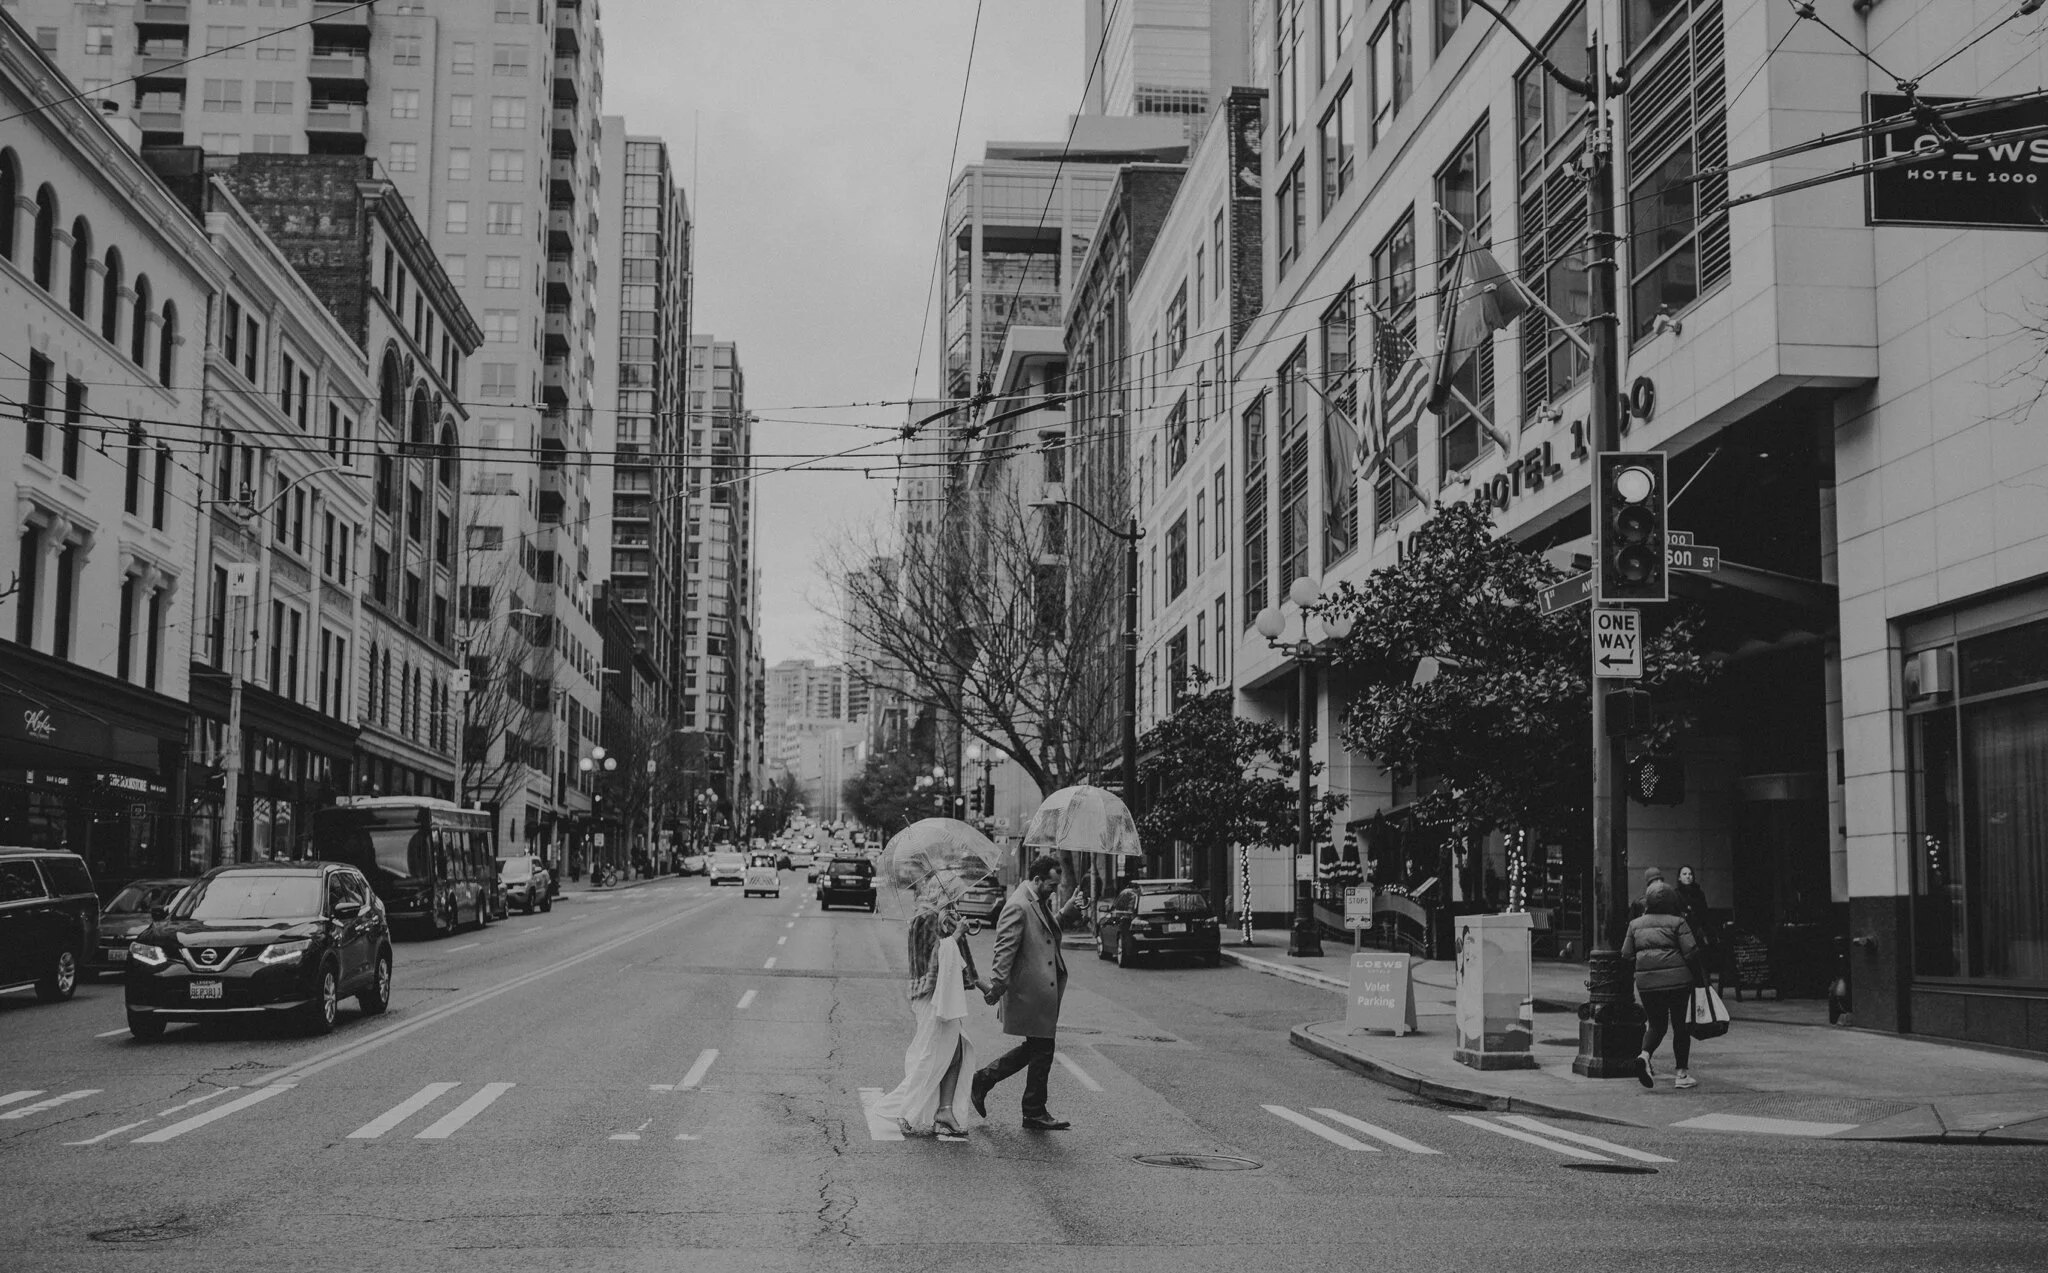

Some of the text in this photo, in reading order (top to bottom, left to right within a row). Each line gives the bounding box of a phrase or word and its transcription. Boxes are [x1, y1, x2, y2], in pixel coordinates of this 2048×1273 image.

[1885, 133, 2048, 163] LOWS
[1907, 169, 2038, 184] HOTEL 1000
[1702, 556, 1715, 569] ST
[1598, 614, 1635, 630] ONE
[1598, 633, 1636, 649] WAY
[1356, 960, 1402, 968] LOEWS
[1364, 982, 1391, 991] Valet
[1357, 995, 1396, 1008] Parking
